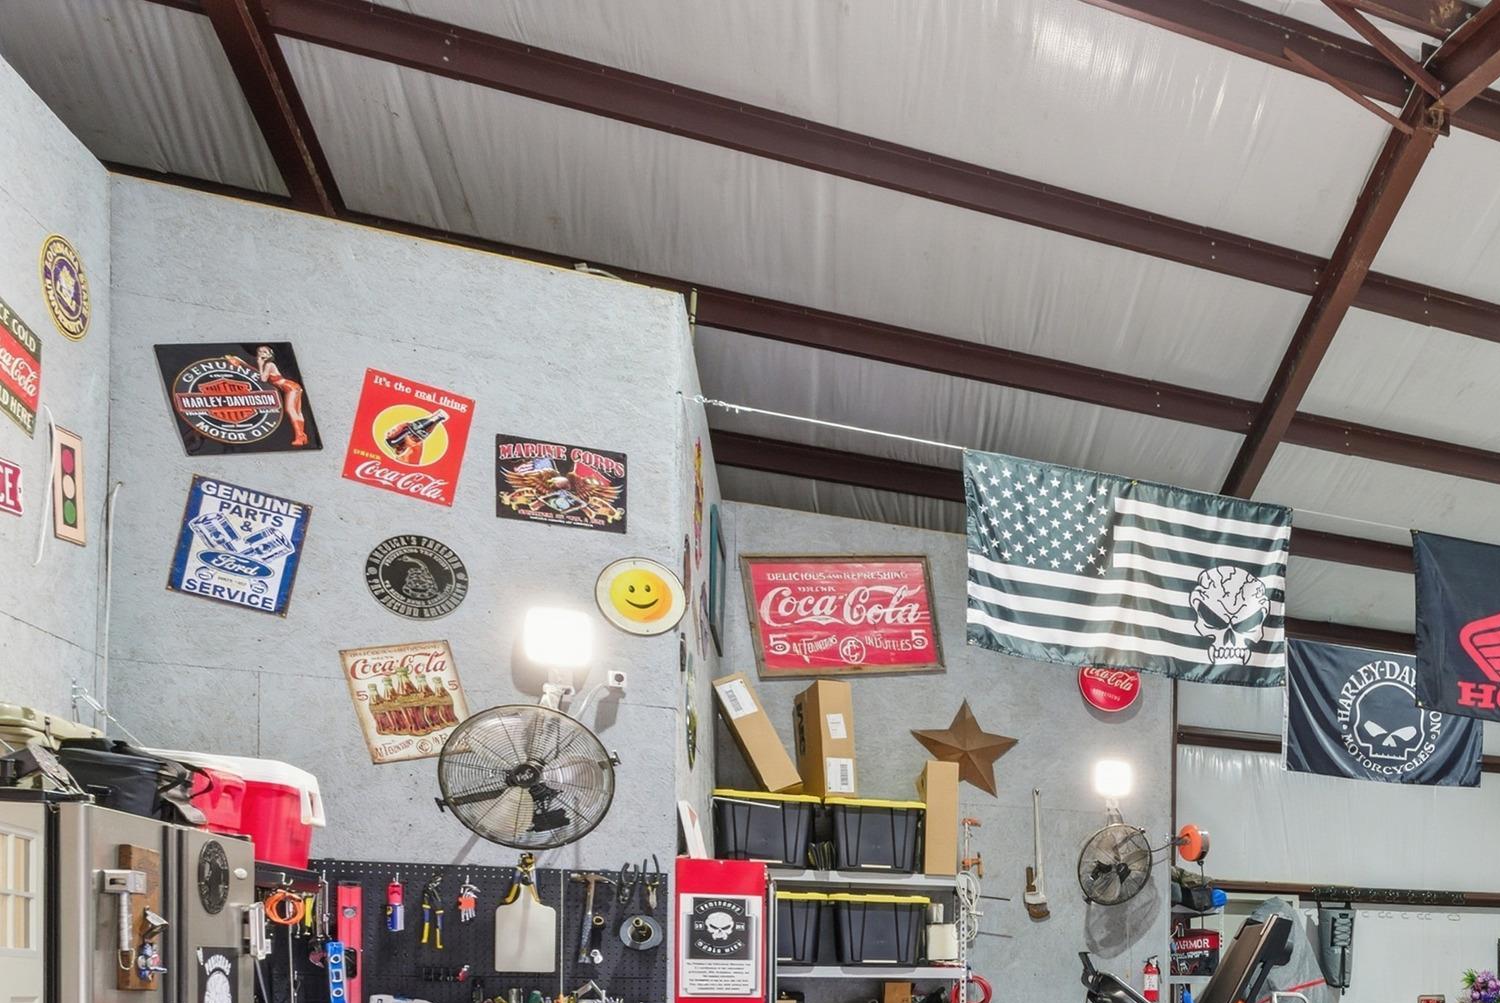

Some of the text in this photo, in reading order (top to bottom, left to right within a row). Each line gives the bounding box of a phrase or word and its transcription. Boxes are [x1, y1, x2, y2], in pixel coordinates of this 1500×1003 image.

[12, 318, 36, 353] COLD
[182, 394, 276, 408] HARLEY-DAVIDSON
[373, 375, 468, 414] It's the real thing
[10, 395, 33, 429] HERE
[196, 420, 276, 441] MOTOR OIL
[498, 442, 625, 478] MARINE CORPS
[200, 480, 303, 518] GENUINE
[219, 501, 284, 528] PARTS
[240, 520, 253, 532] &
[211, 553, 259, 576] Ford
[766, 571, 826, 582] DELICIOUS
[185, 578, 274, 610] SERVICE
[760, 584, 923, 627] Coca-Cola
[350, 651, 448, 680] Coca-Cola
[1341, 732, 1436, 775] MOTORCYCLES
